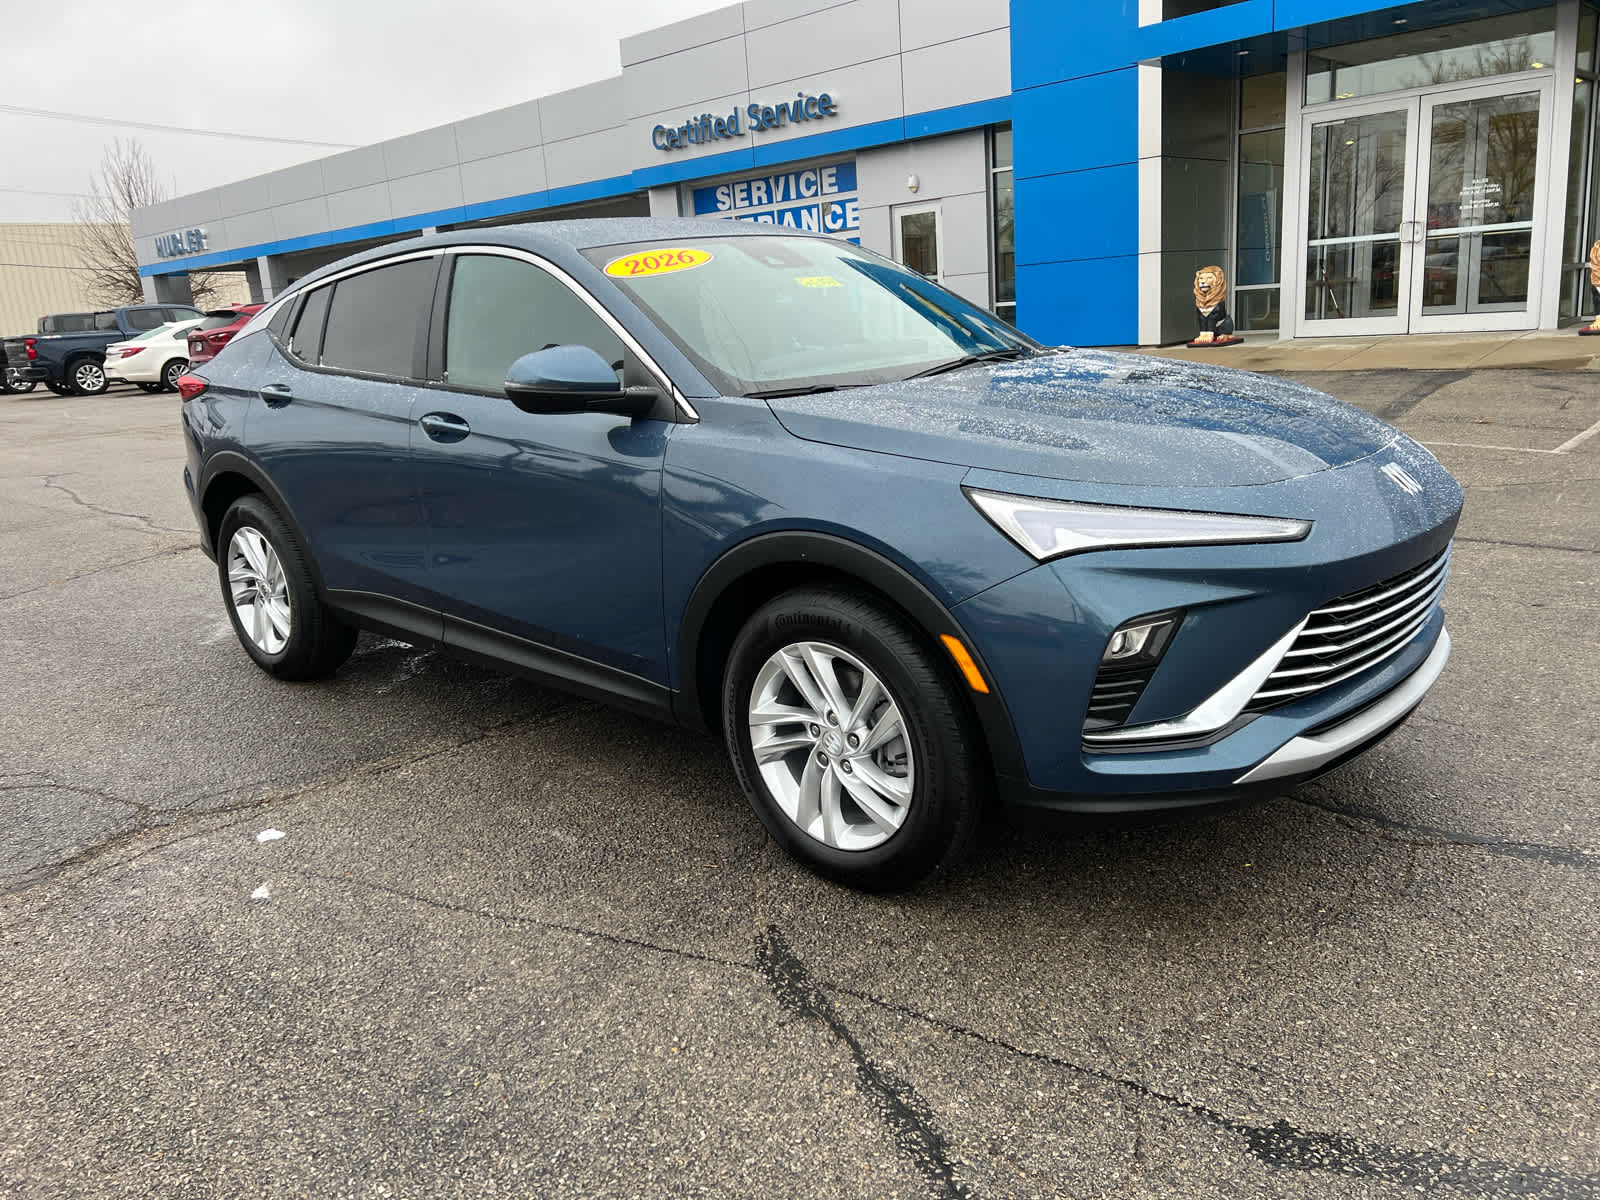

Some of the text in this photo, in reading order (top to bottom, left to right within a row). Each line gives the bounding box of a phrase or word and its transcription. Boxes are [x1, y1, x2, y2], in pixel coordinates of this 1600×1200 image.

[652, 92, 833, 150] Certified Service
[715, 166, 839, 211] SERVICE
[624, 250, 695, 276] 2026
